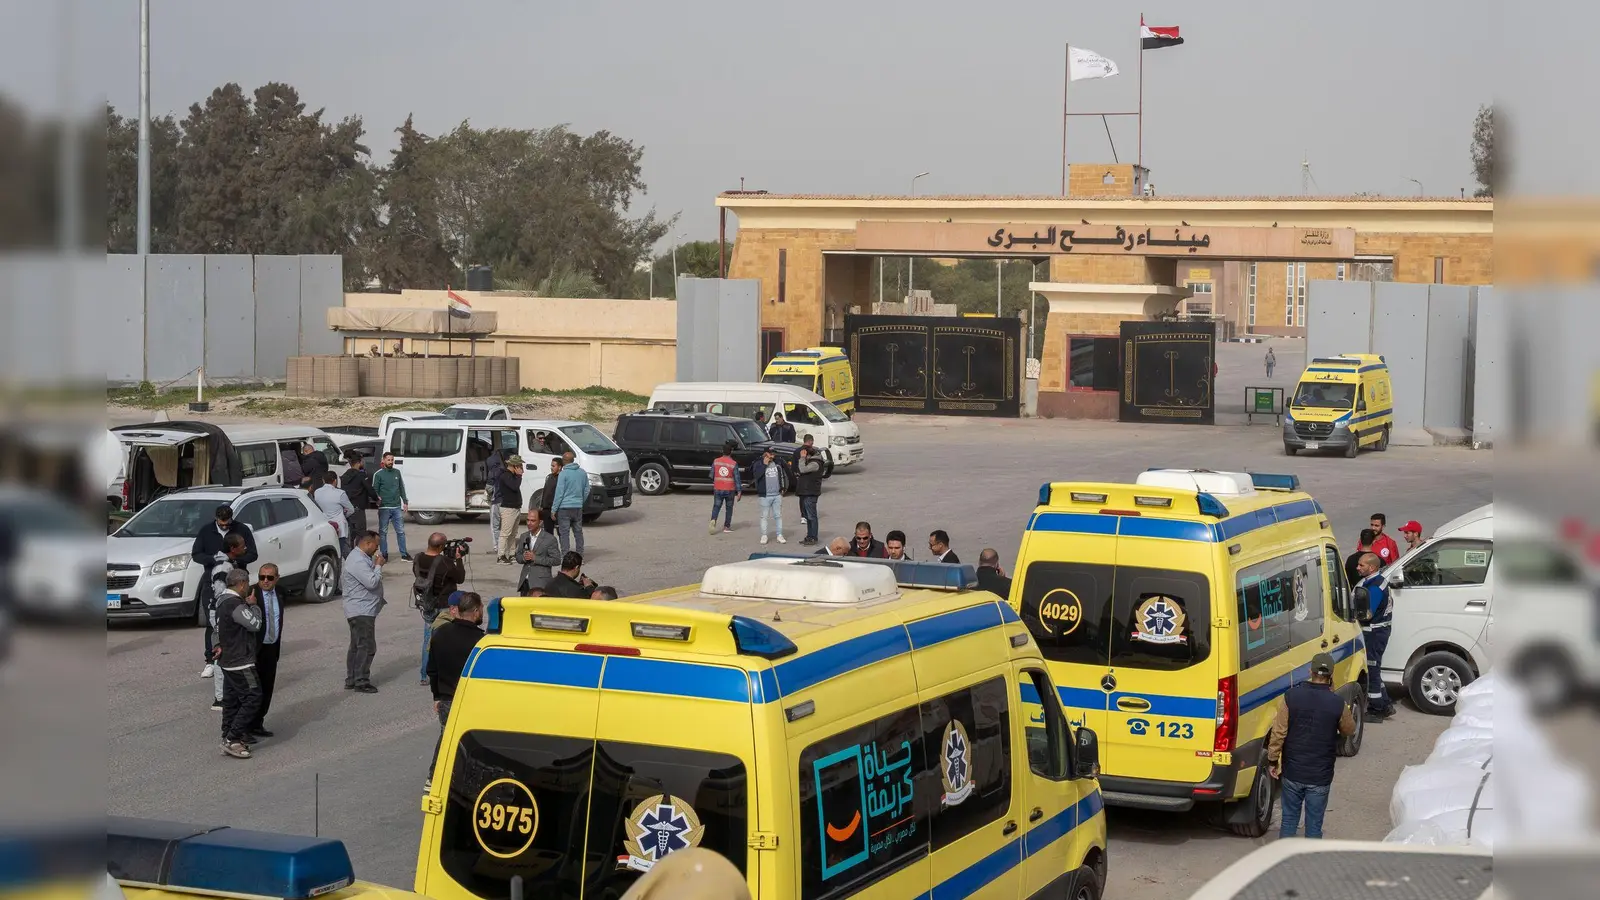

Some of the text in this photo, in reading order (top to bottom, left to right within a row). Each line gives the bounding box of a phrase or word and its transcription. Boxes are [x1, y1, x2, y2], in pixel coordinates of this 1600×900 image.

[1059, 225, 1134, 252] رفح
[1137, 227, 1211, 253] ميناء
[1042, 602, 1078, 622] 4029
[1156, 721, 1194, 740] 123
[864, 740, 911, 780] حياة
[867, 765, 914, 819] كريمة
[478, 802, 533, 834] 3975
